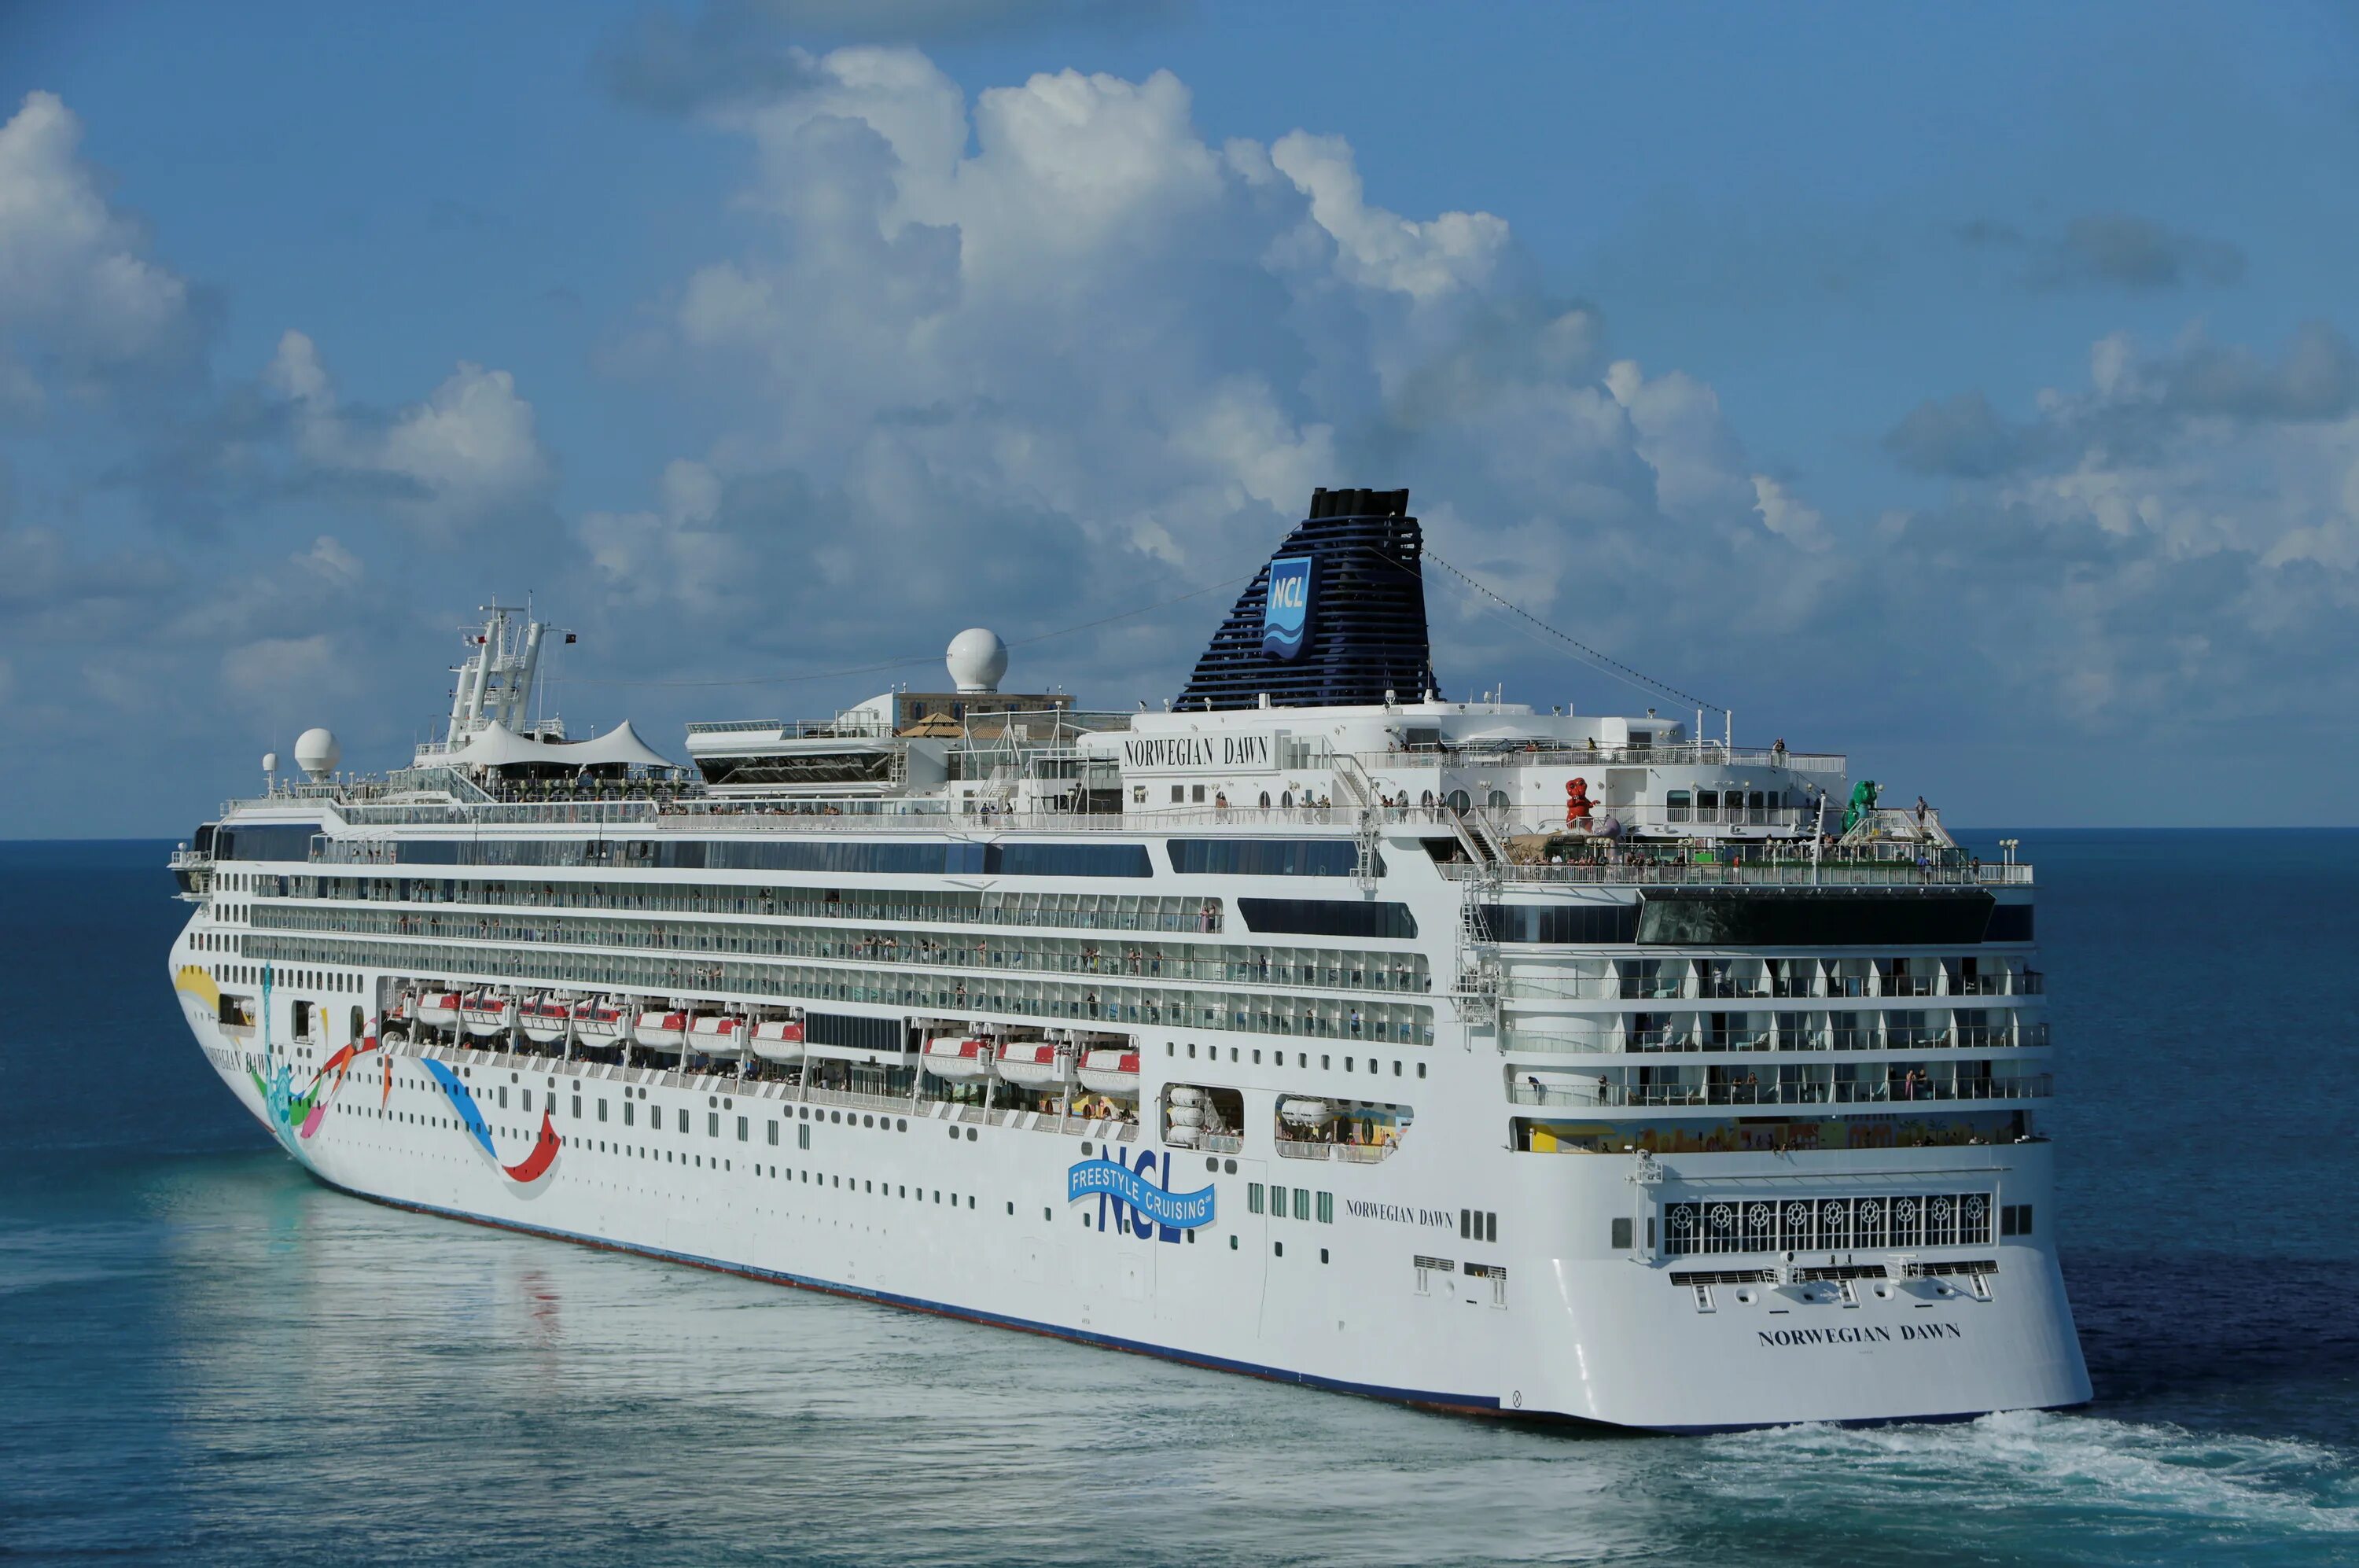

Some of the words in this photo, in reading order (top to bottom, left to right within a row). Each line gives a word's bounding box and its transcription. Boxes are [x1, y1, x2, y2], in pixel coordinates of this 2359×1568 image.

[1272, 576, 1303, 609] NCL
[1124, 738, 1213, 767] NORWEGIAN
[1224, 736, 1268, 764] DAWN
[1073, 1168, 1139, 1202] FREESTYLE
[1099, 1144, 1181, 1244] NCL
[1346, 1199, 1415, 1224] NORWEGIAN
[1419, 1209, 1453, 1229] DAWN
[1757, 1326, 1890, 1347] NORWEGIAN
[1900, 1323, 1961, 1341] DAWN
